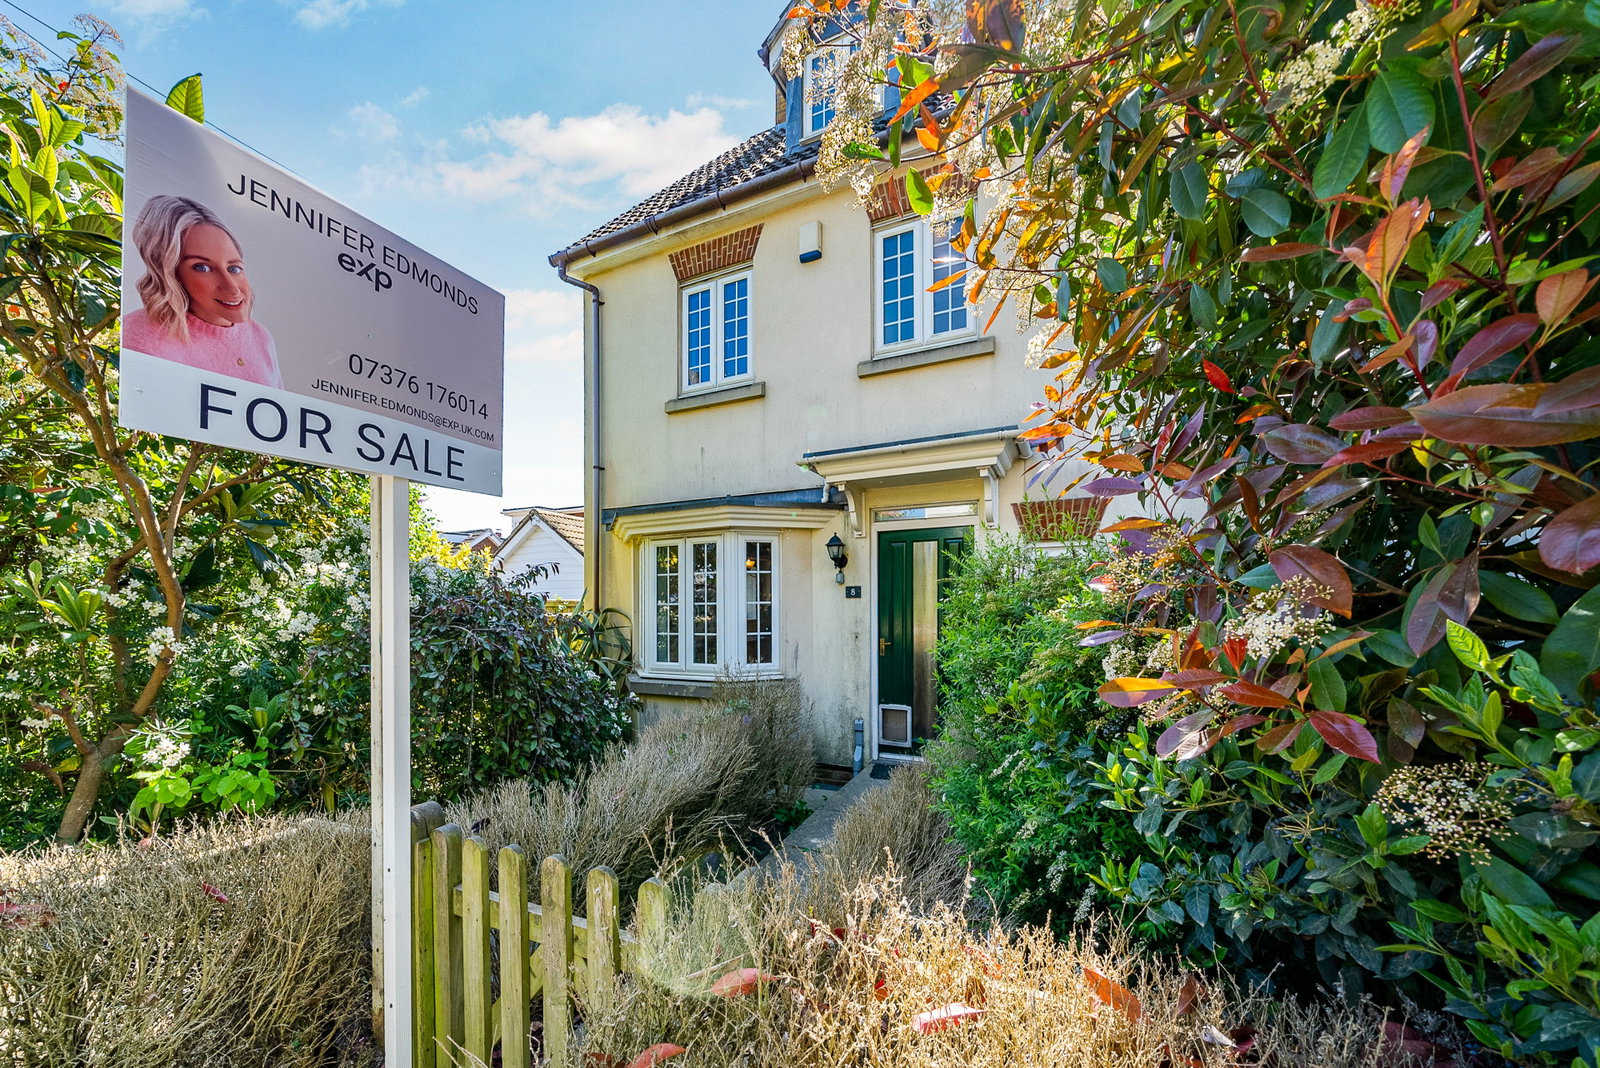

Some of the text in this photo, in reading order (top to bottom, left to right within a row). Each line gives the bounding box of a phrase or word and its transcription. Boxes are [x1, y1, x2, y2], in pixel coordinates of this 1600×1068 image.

[227, 174, 479, 315] JENNIFER EDMONDS
[337, 251, 393, 293] exp
[311, 377, 495, 443] JENNIFER.EDMONDS@EXP.UK.COM
[348, 353, 489, 420] 07376 176014
[199, 382, 465, 482] FOR SALE
[850, 588, 856, 596] 8
